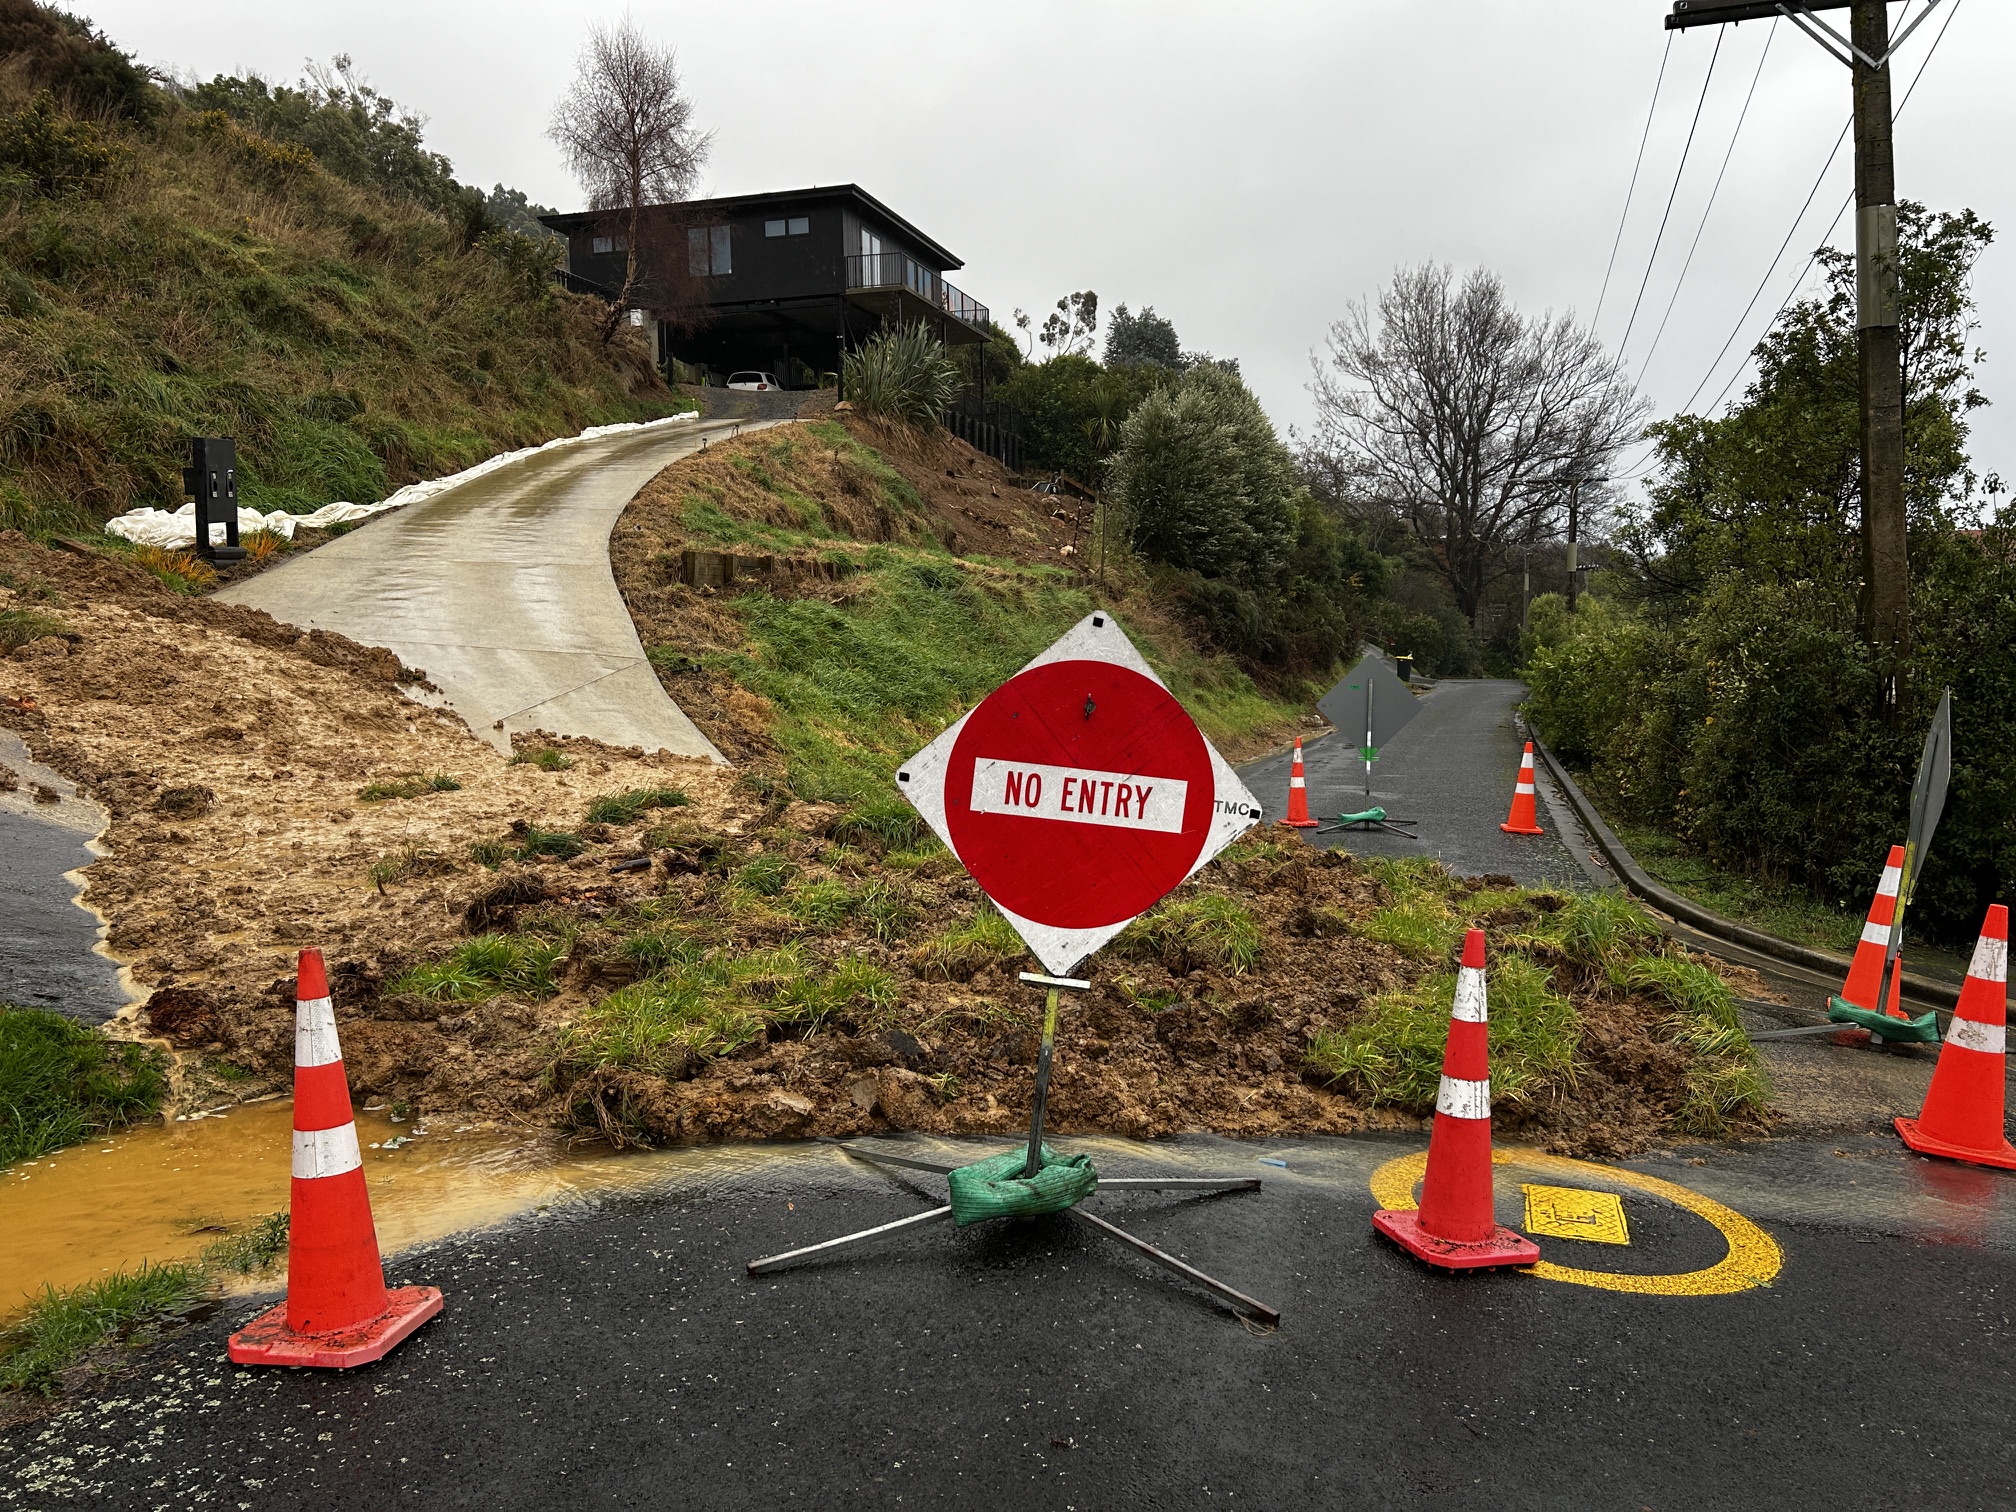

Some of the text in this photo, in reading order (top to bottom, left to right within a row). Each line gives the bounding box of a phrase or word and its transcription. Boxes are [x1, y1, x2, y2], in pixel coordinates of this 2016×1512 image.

[1004, 770, 1153, 820] NO ENTRY
[1214, 799, 1250, 816] TMC
